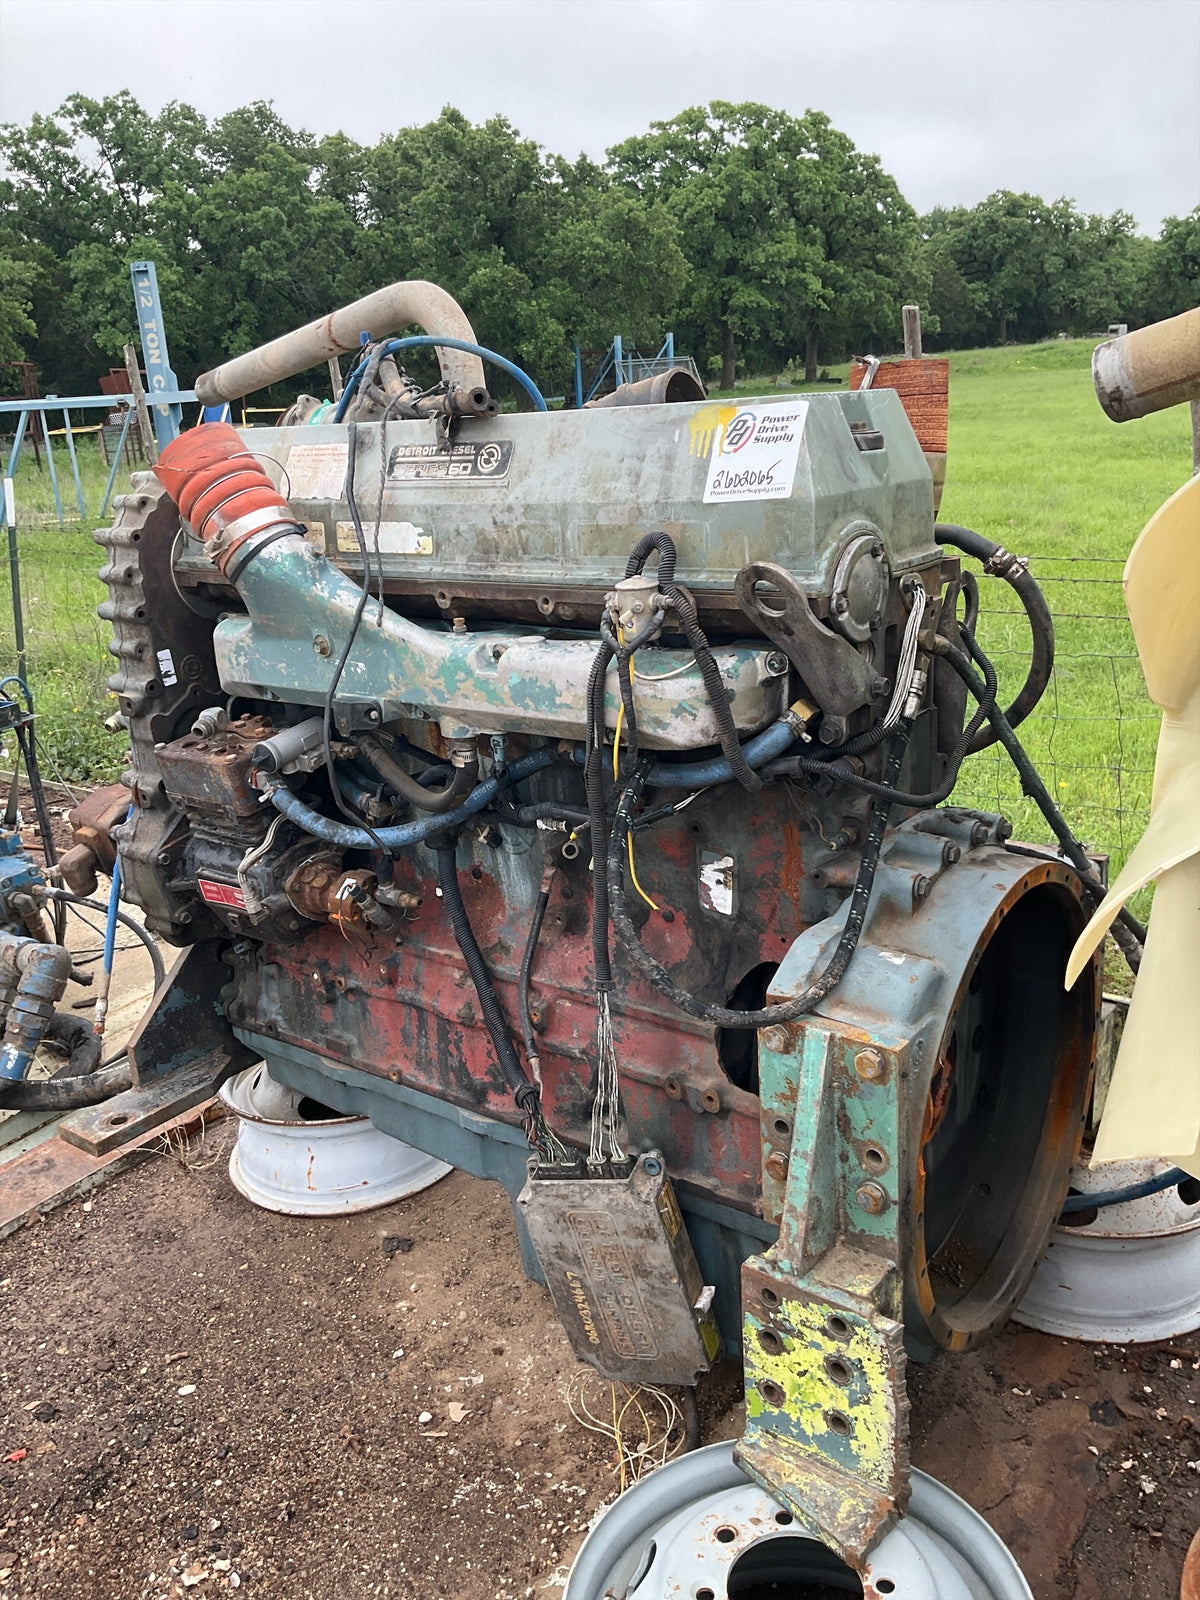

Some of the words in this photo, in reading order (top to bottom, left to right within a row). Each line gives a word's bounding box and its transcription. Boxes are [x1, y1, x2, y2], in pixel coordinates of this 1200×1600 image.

[138, 277, 153, 308] 1/2
[144, 318, 161, 364] TON
[152, 374, 169, 417] CP
[761, 414, 800, 424] Power
[757, 425, 788, 434] Drive
[753, 433, 794, 444] Supply
[398, 447, 437, 457] DETROIT
[448, 463, 472, 475] 60
[713, 460, 782, 489] 2602065
